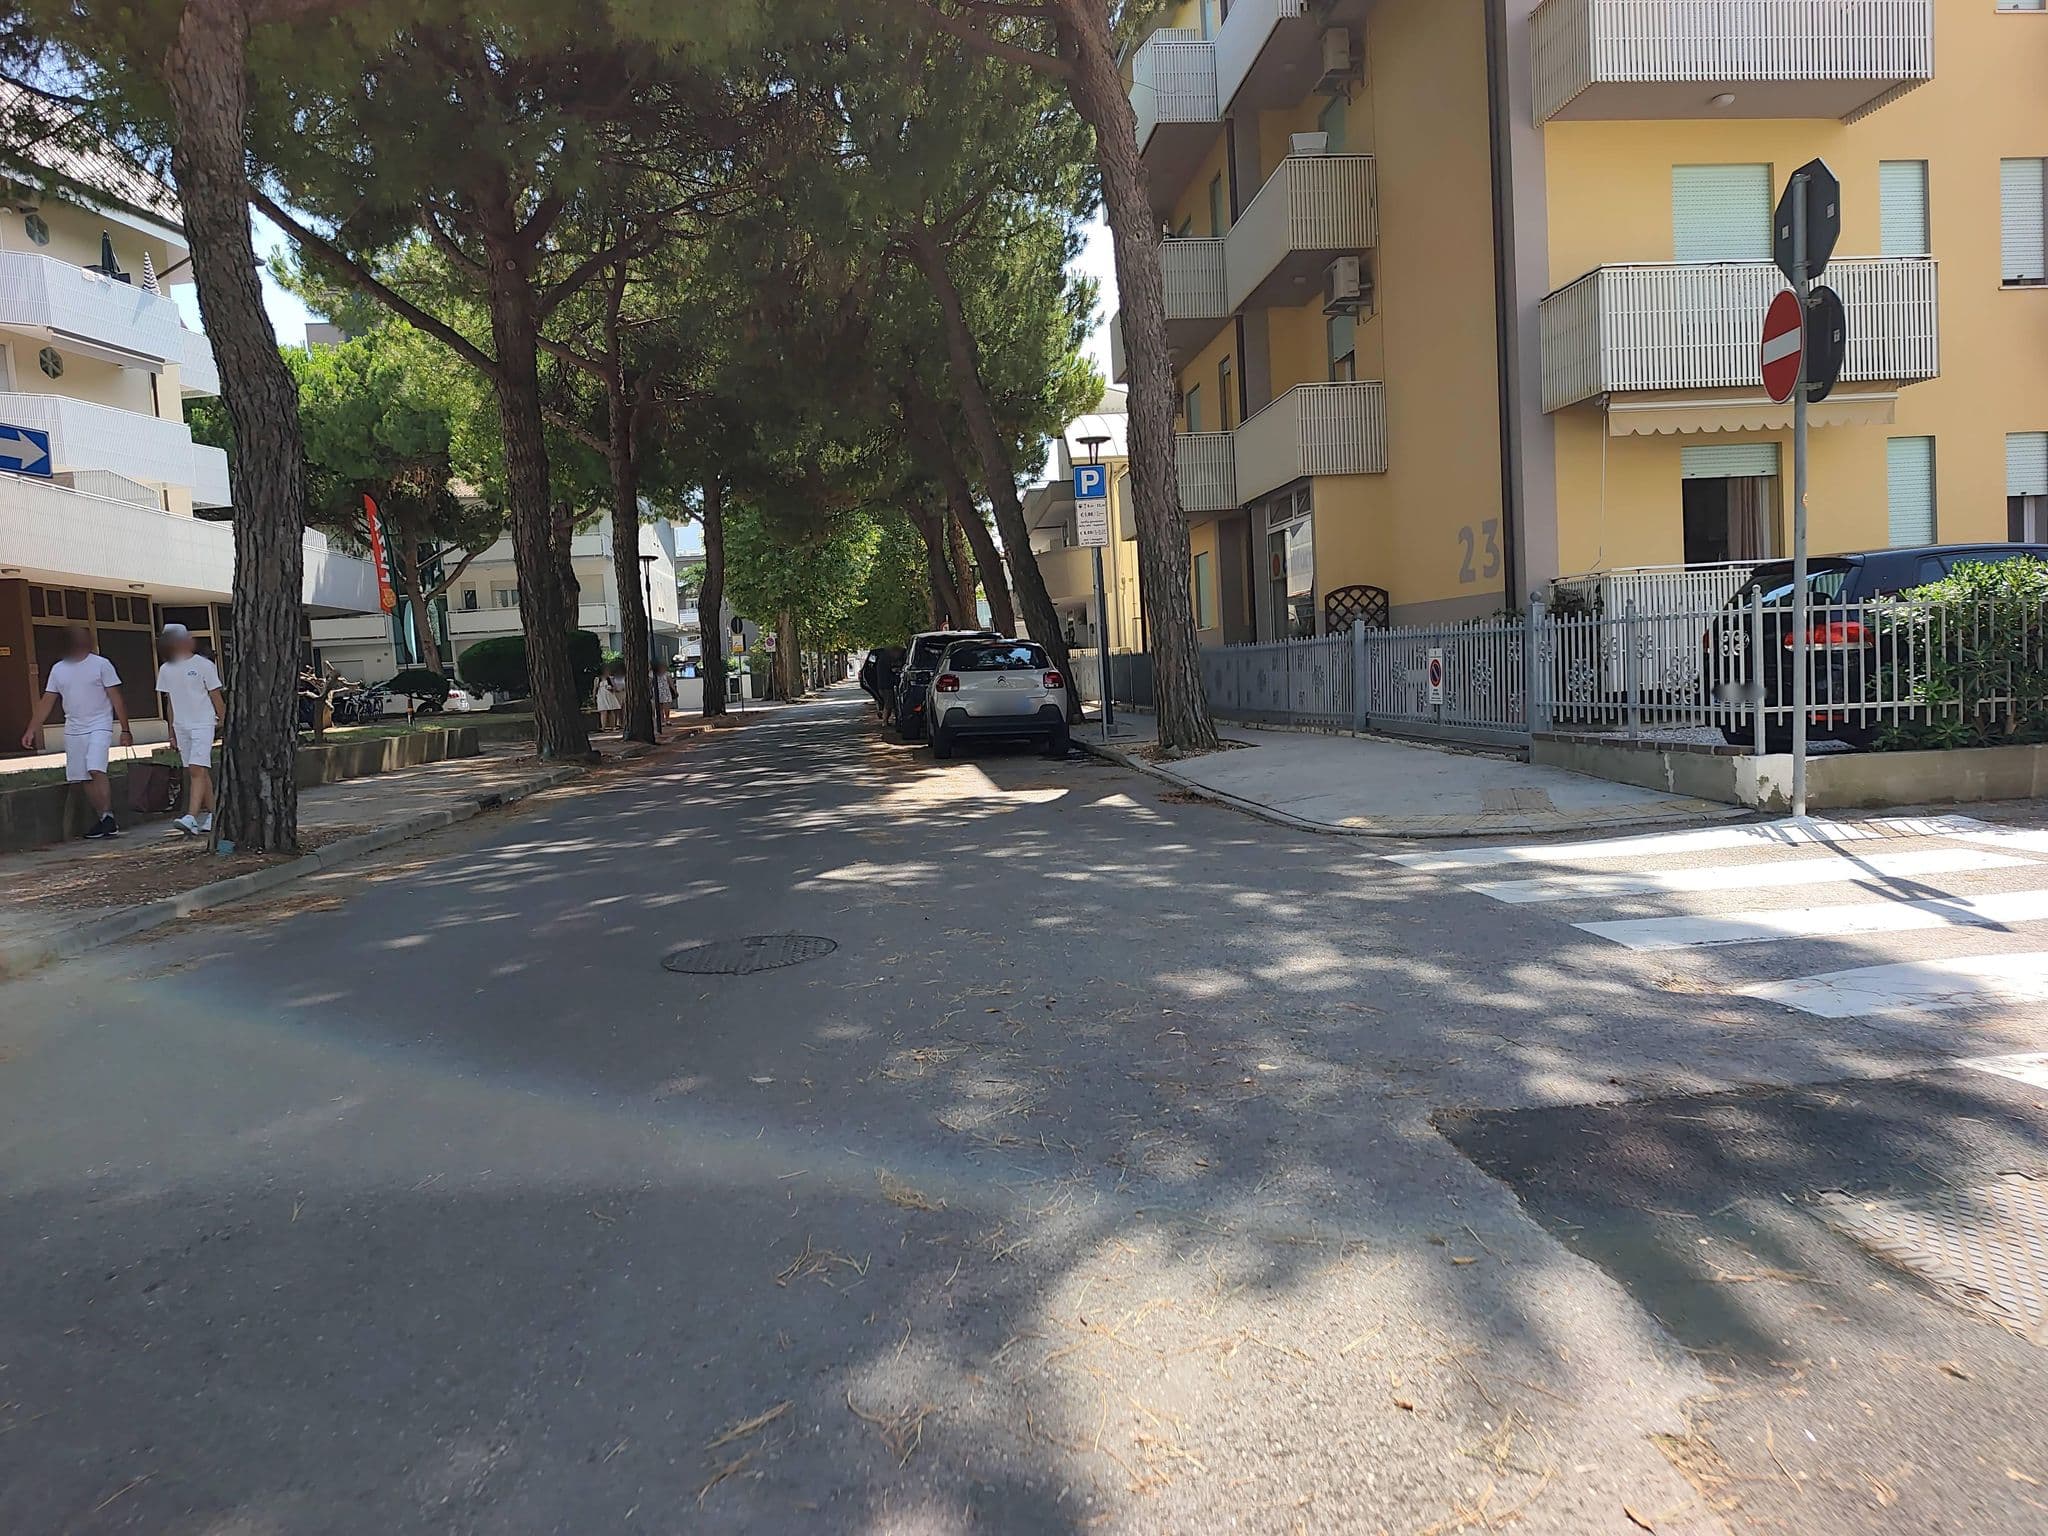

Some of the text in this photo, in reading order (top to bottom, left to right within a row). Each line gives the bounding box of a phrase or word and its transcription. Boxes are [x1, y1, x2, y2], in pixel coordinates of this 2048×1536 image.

[1081, 470, 1099, 495] P
[372, 515, 391, 583] PIZZA
[1458, 518, 1501, 584] 23
